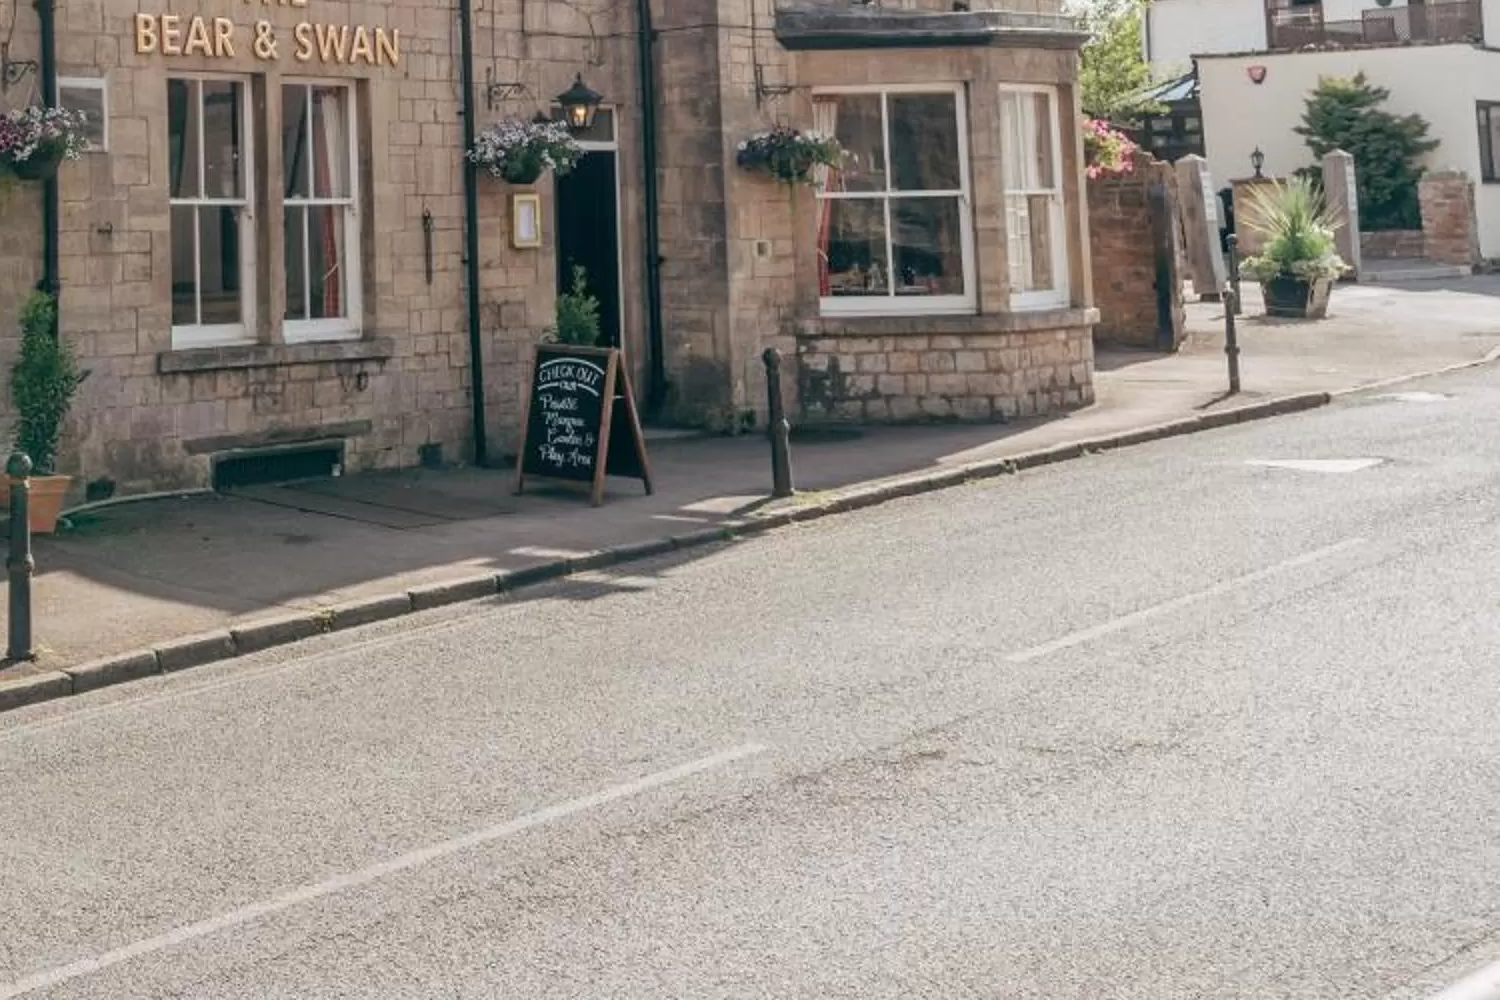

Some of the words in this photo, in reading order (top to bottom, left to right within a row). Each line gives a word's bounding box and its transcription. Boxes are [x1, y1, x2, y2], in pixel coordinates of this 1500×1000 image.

[135, 12, 236, 58] BEAR
[253, 19, 280, 61] &
[294, 21, 401, 68] SWAN
[539, 364, 575, 382] CHECK
[576, 366, 599, 385] OUT
